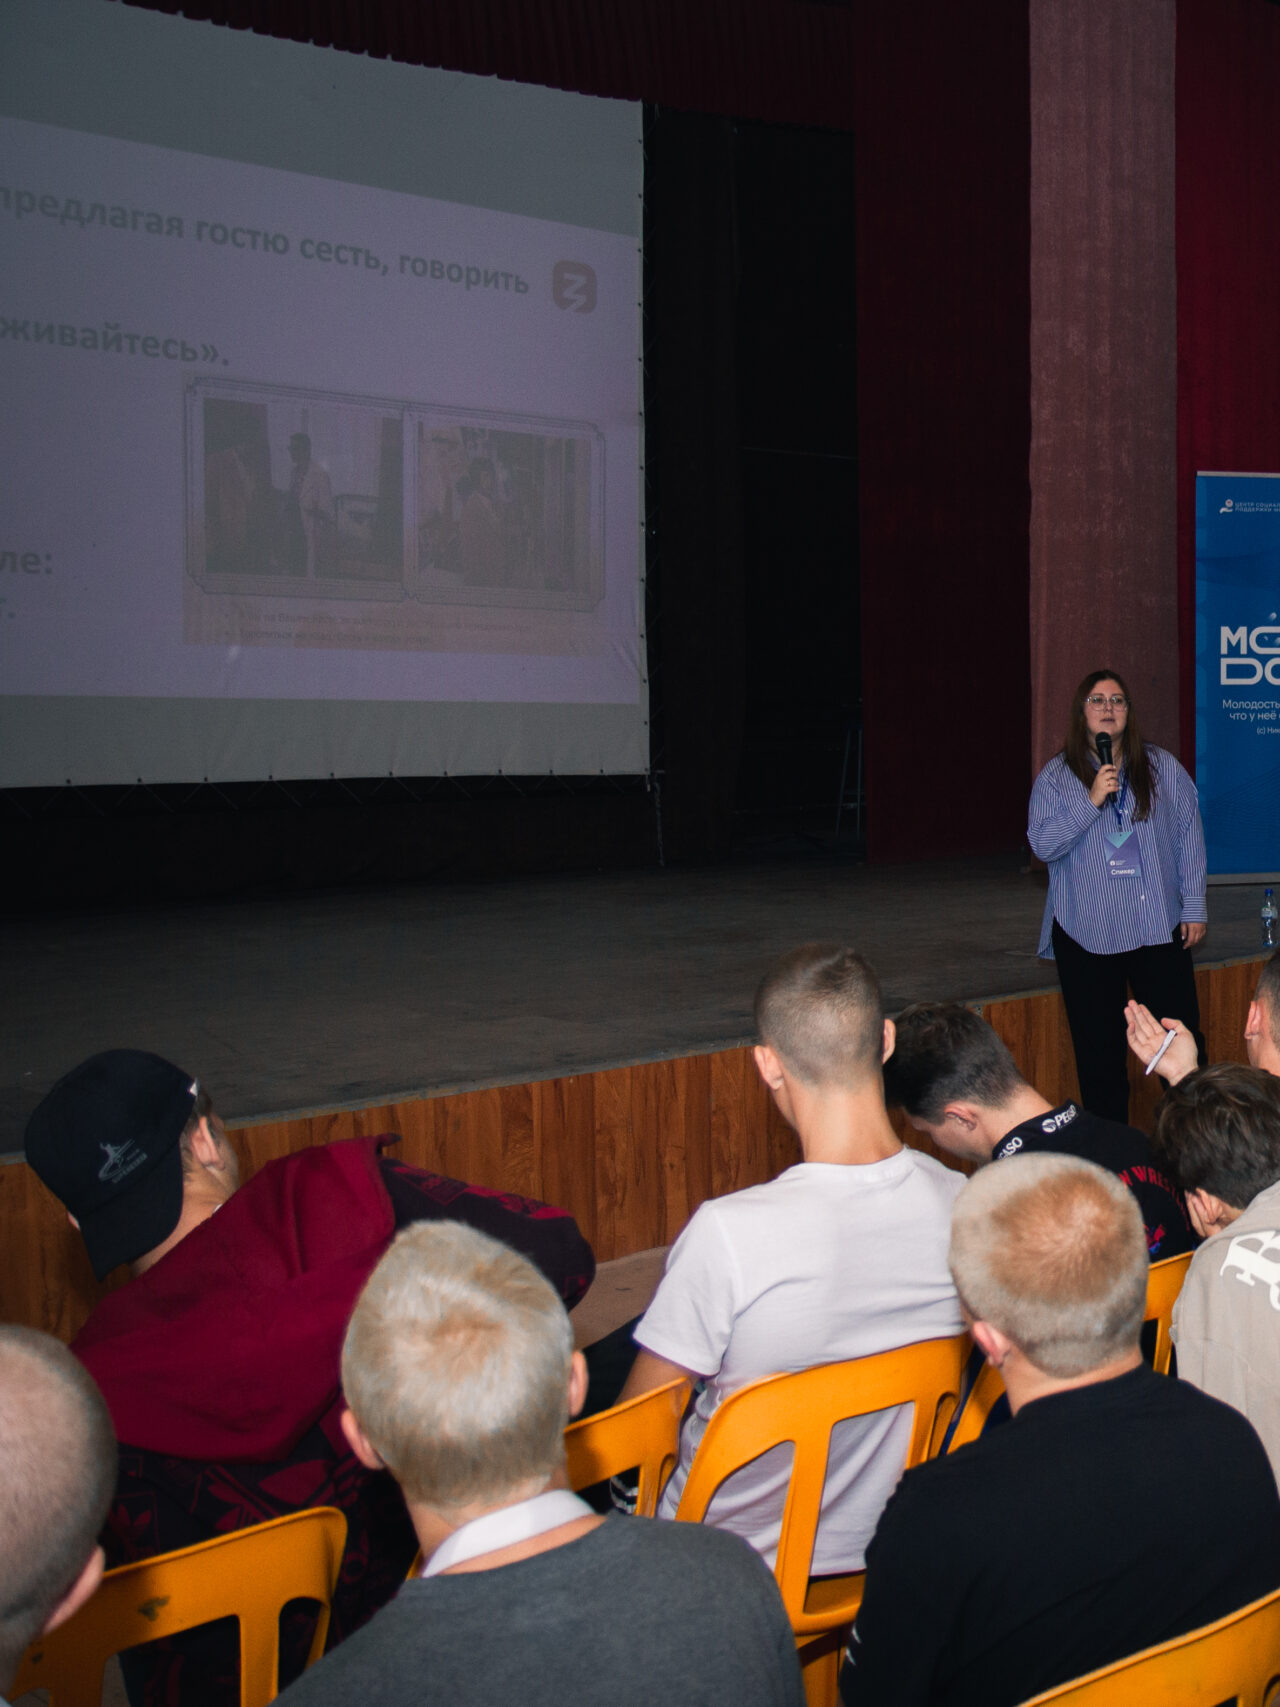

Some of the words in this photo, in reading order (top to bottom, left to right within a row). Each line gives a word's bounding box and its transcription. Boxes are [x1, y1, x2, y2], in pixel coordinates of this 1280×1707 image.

[195, 220, 290, 256] гостю
[299, 237, 390, 276] сесть,
[398, 254, 530, 295] говорить
[1222, 699, 1280, 710] Молодость
[1229, 712, 1248, 721] что
[1248, 712, 1255, 722] у
[1257, 710, 1277, 721] неё
